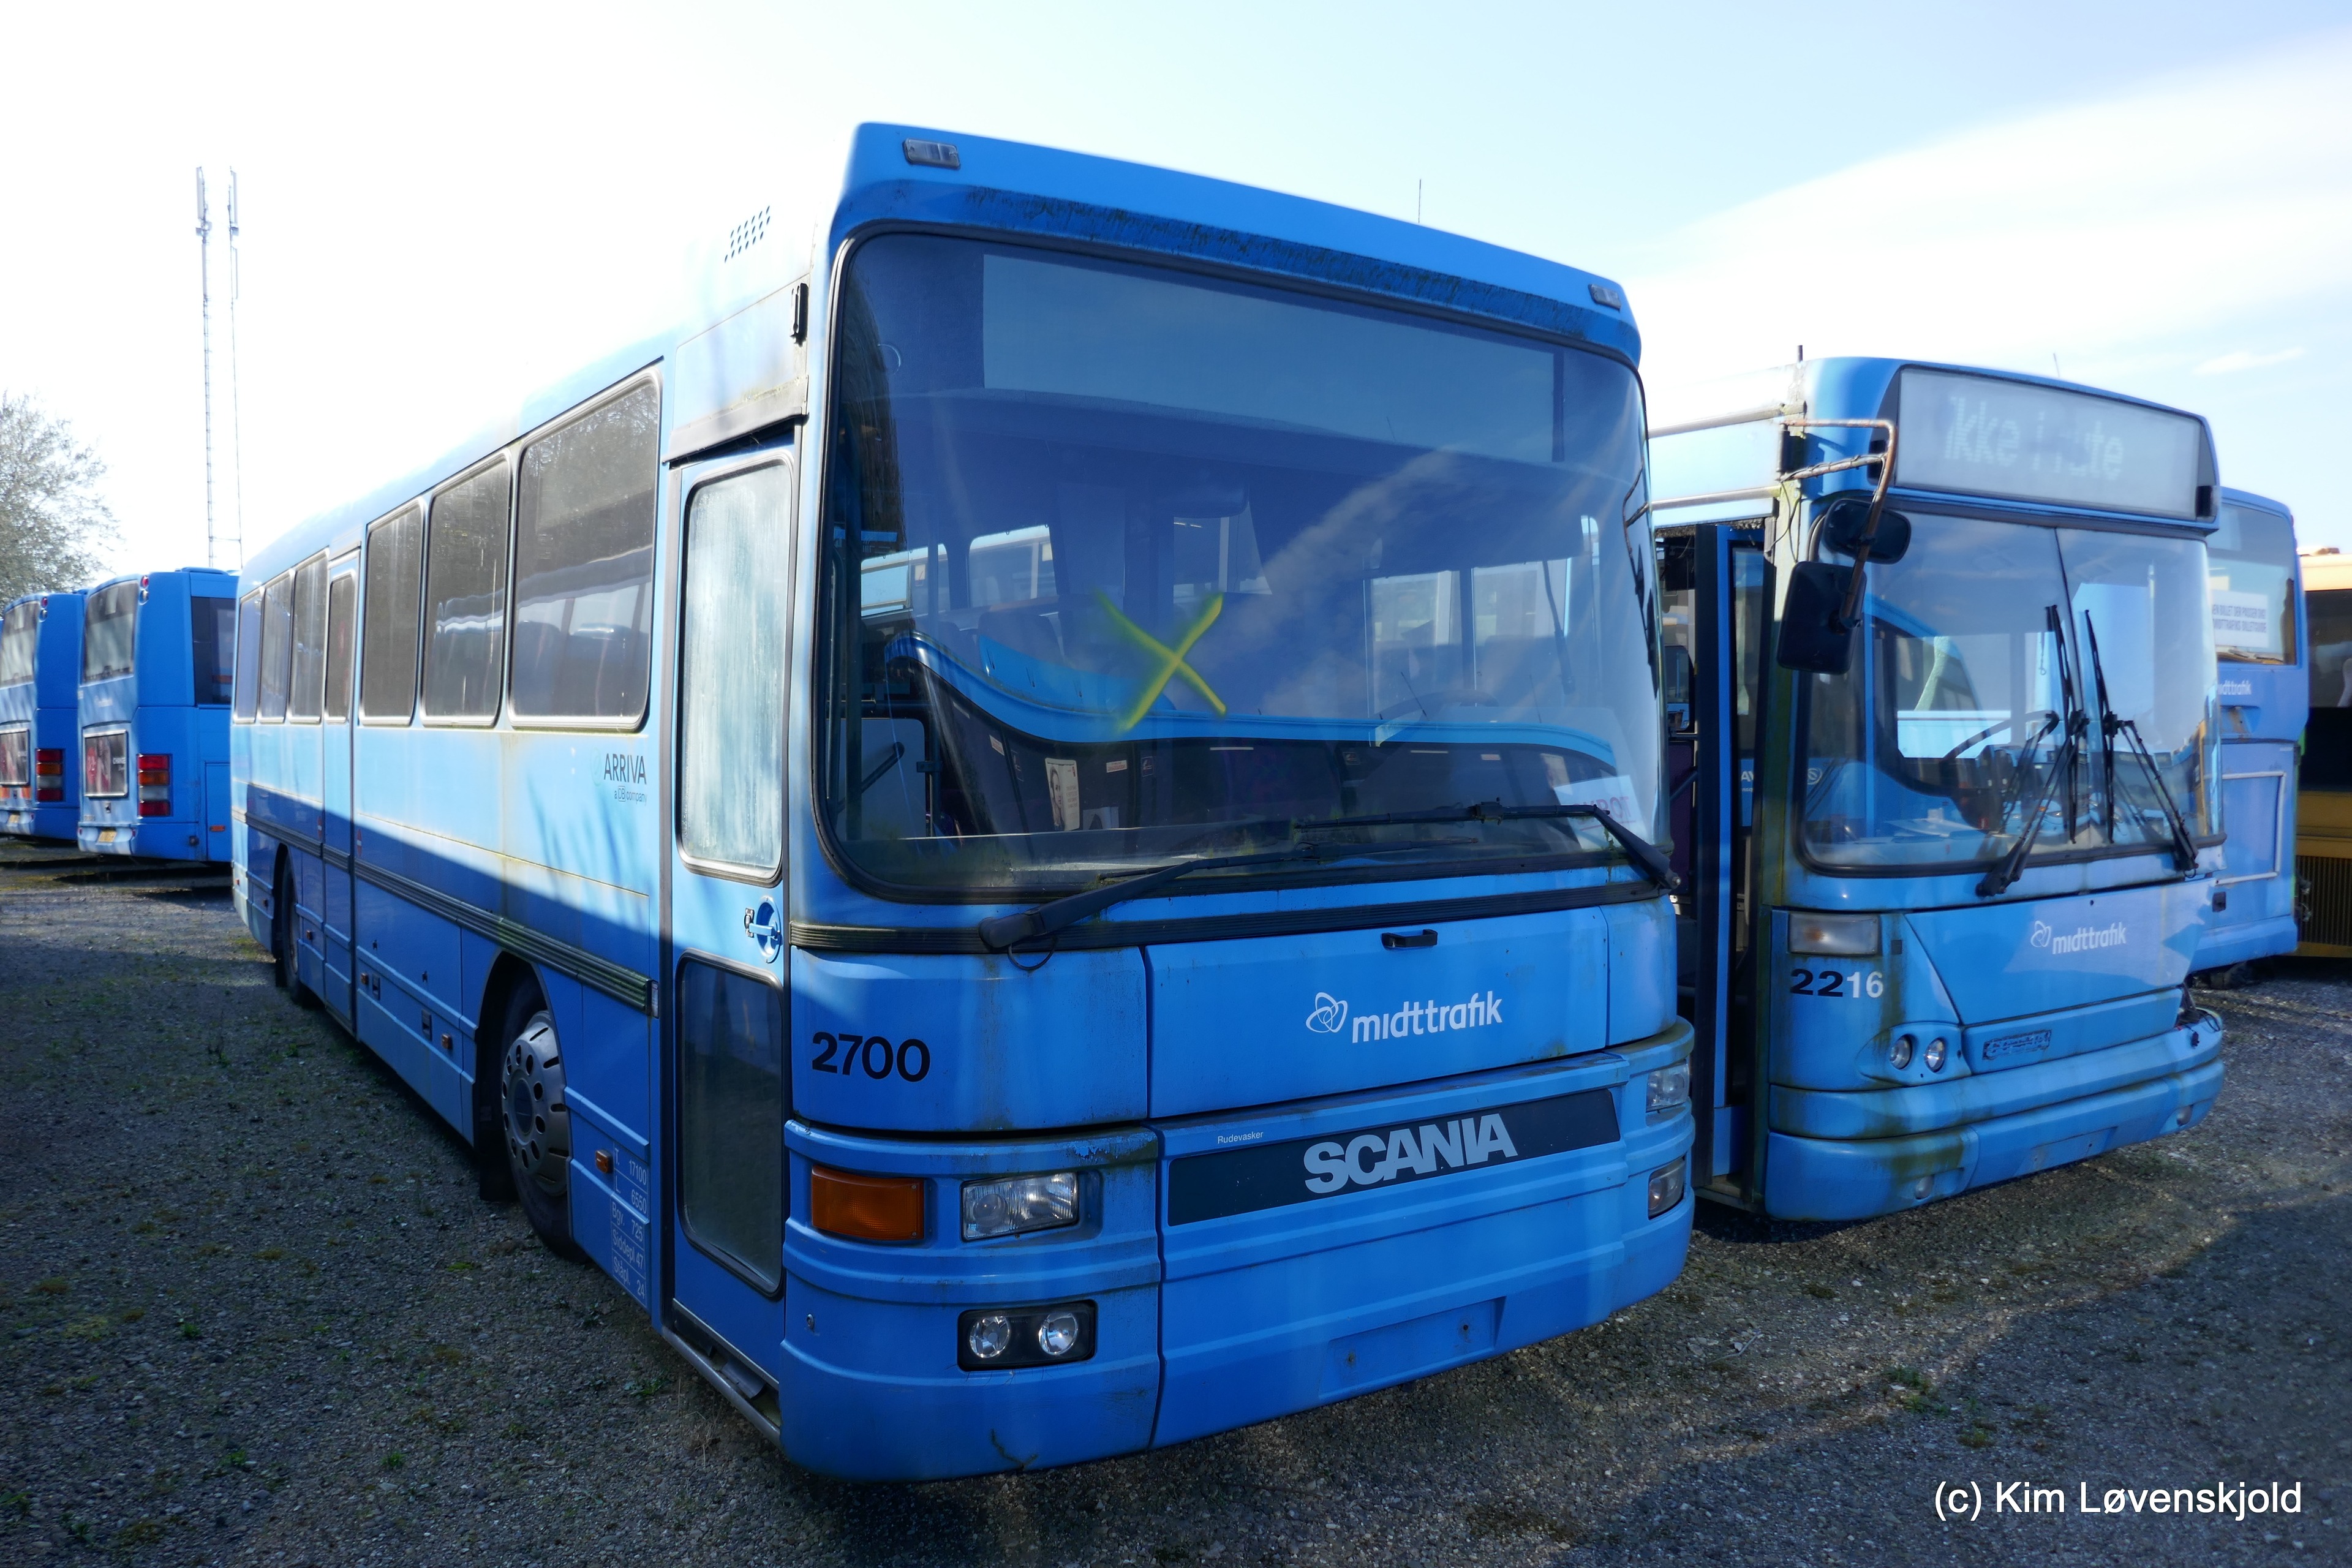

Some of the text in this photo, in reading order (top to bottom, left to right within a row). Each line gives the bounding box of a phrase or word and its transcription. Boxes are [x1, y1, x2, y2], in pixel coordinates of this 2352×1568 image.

[603, 753, 647, 785] ARRIVA
[618, 788, 625, 800] DB
[627, 791, 647, 806] company
[2052, 922, 2127, 955] midttrafik
[1790, 968, 1883, 998] 2216
[1352, 990, 1503, 1044] midttrafik
[812, 1031, 930, 1082] 2700
[1217, 1131, 1264, 1144] Rudevasker
[1303, 1113, 1518, 1194] SCANIA
[629, 1159, 647, 1186] 17100
[631, 1189, 647, 1214] 6550
[631, 1219, 643, 1242] 725
[636, 1252, 644, 1270] 47
[636, 1279, 645, 1299] 24
